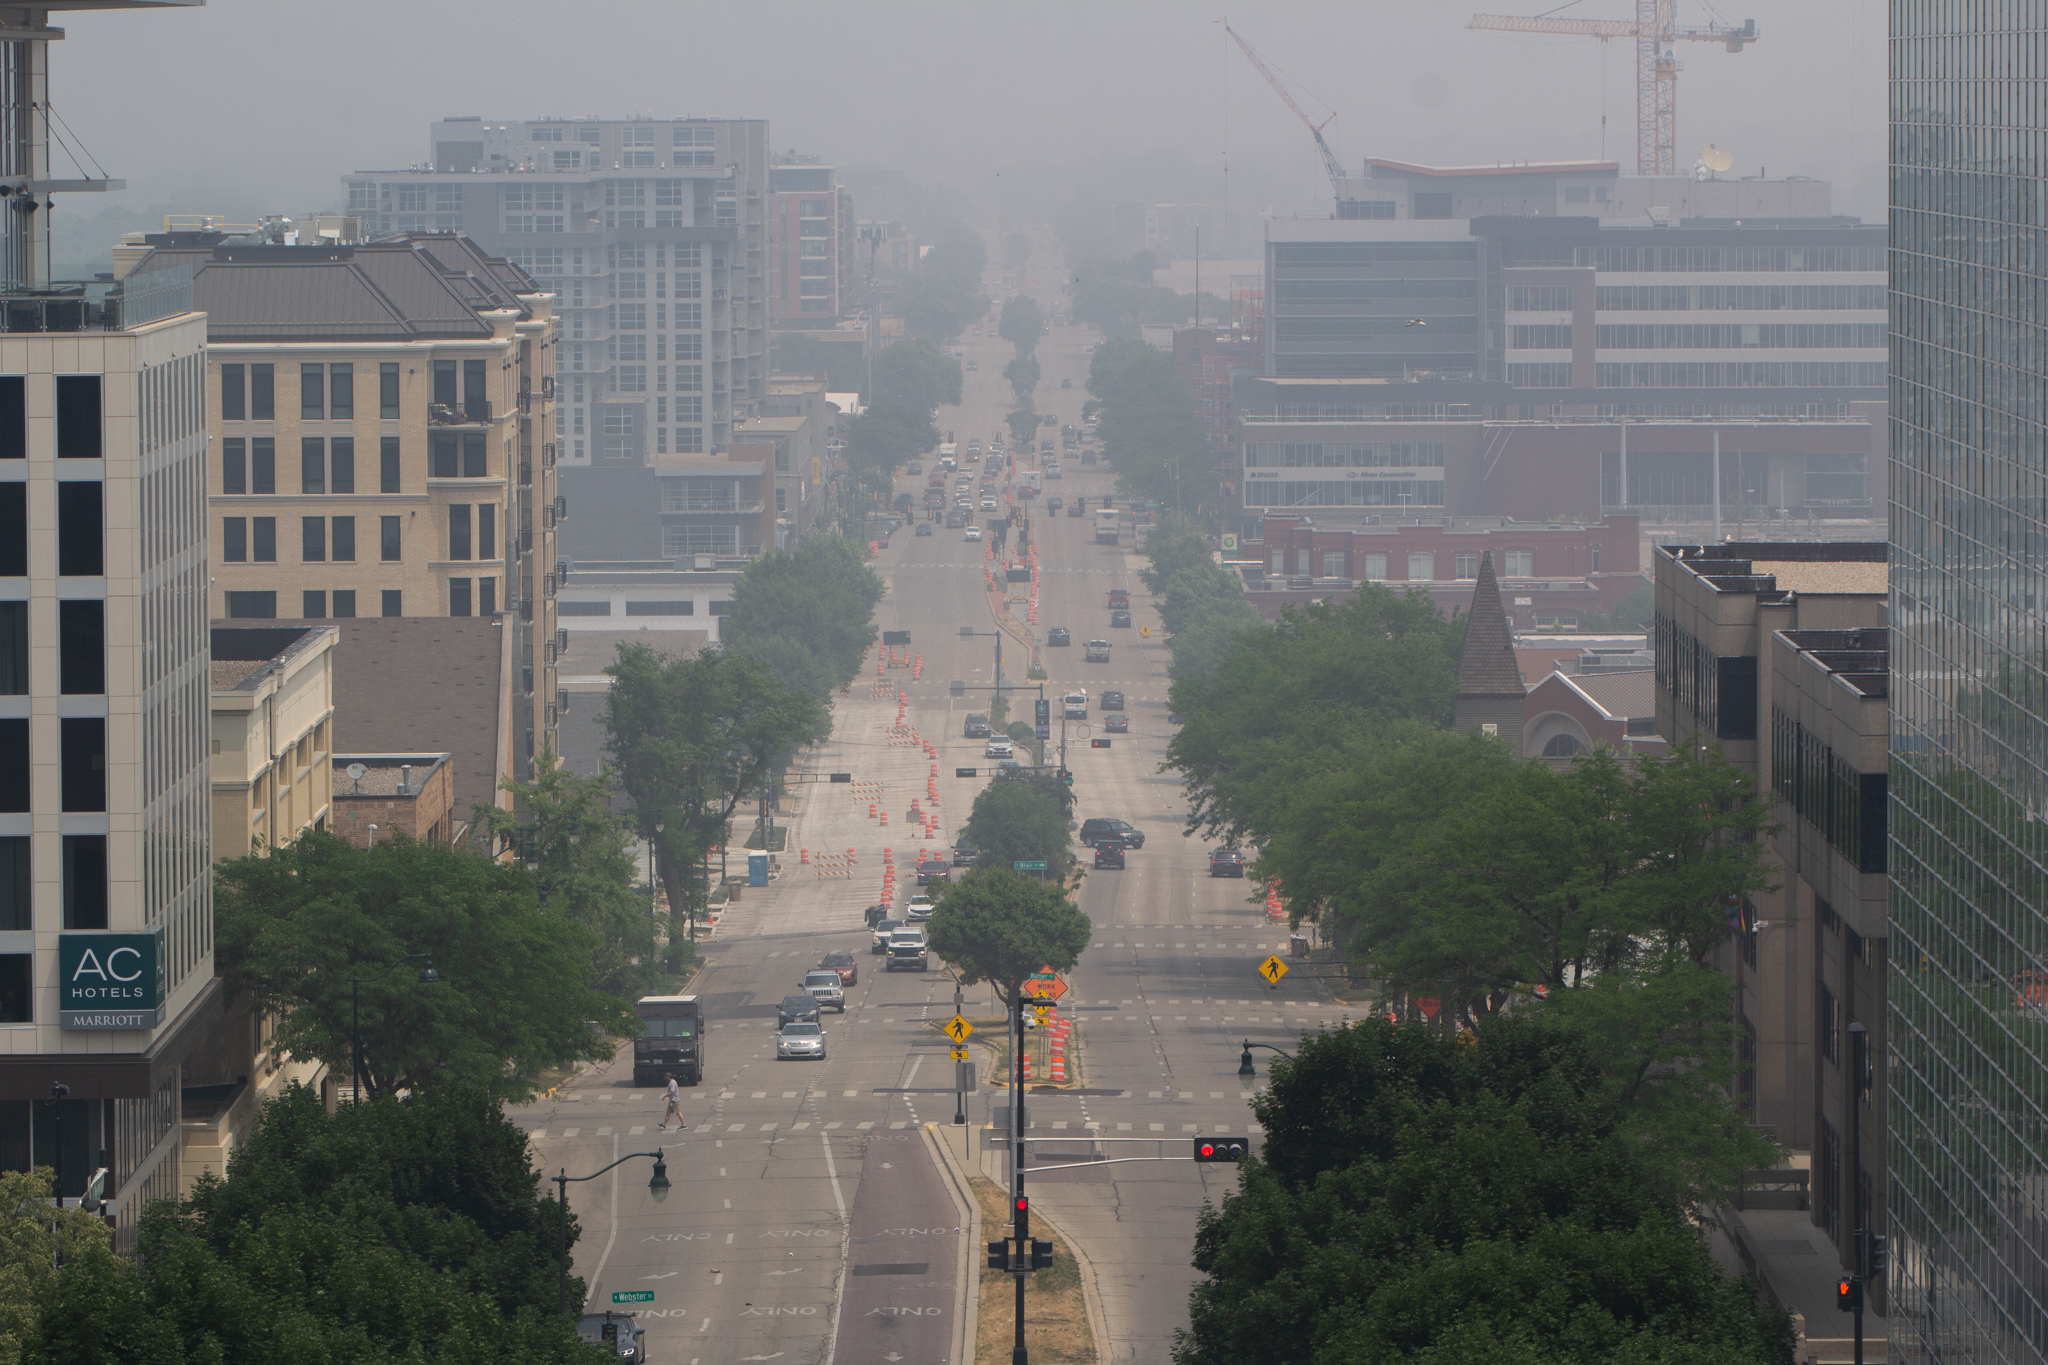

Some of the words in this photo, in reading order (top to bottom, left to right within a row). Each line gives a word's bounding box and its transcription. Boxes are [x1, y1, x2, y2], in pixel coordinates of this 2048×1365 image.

[72, 947, 142, 982] AC
[72, 987, 143, 998] HOTELS
[73, 1015, 143, 1026] MARRIOTT
[757, 1230, 829, 1238] ONLY
[874, 1228, 946, 1236] ONLY
[618, 1293, 646, 1301] Webster
[738, 1307, 817, 1316] ONLY
[864, 1307, 942, 1316] ONLY
